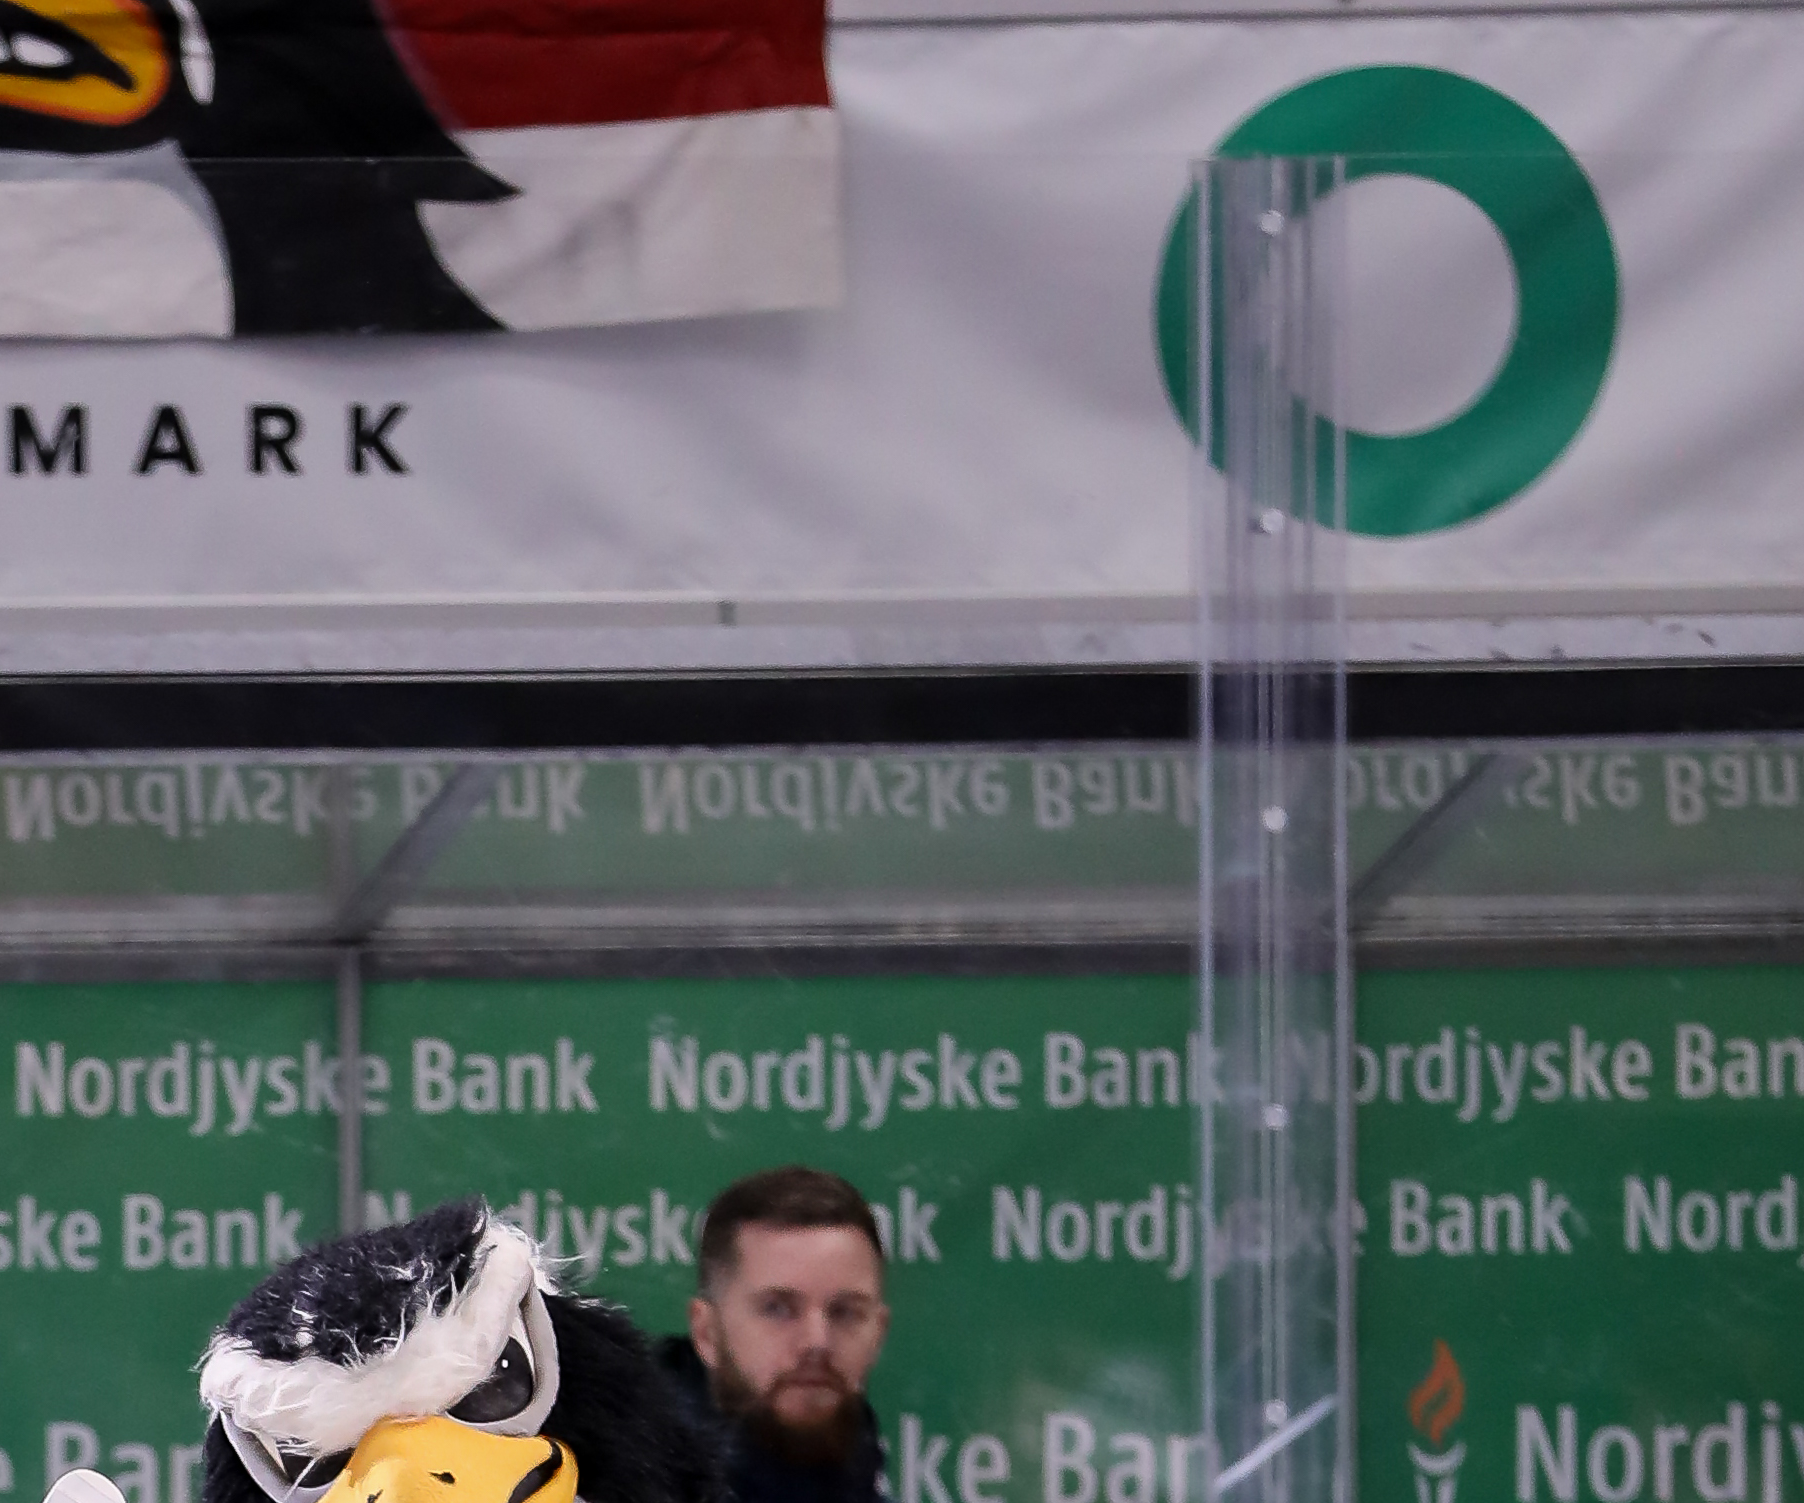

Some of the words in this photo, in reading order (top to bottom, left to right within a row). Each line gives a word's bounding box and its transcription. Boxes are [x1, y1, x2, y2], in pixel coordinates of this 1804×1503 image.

[14, 1040, 393, 1137] Nordjyske
[413, 1037, 599, 1115] Bank
[648, 1034, 1023, 1133] Nordjyske
[122, 1192, 304, 1271] Bank
[1389, 1177, 1575, 1258] Bank
[1622, 1173, 1804, 1270] Nord
